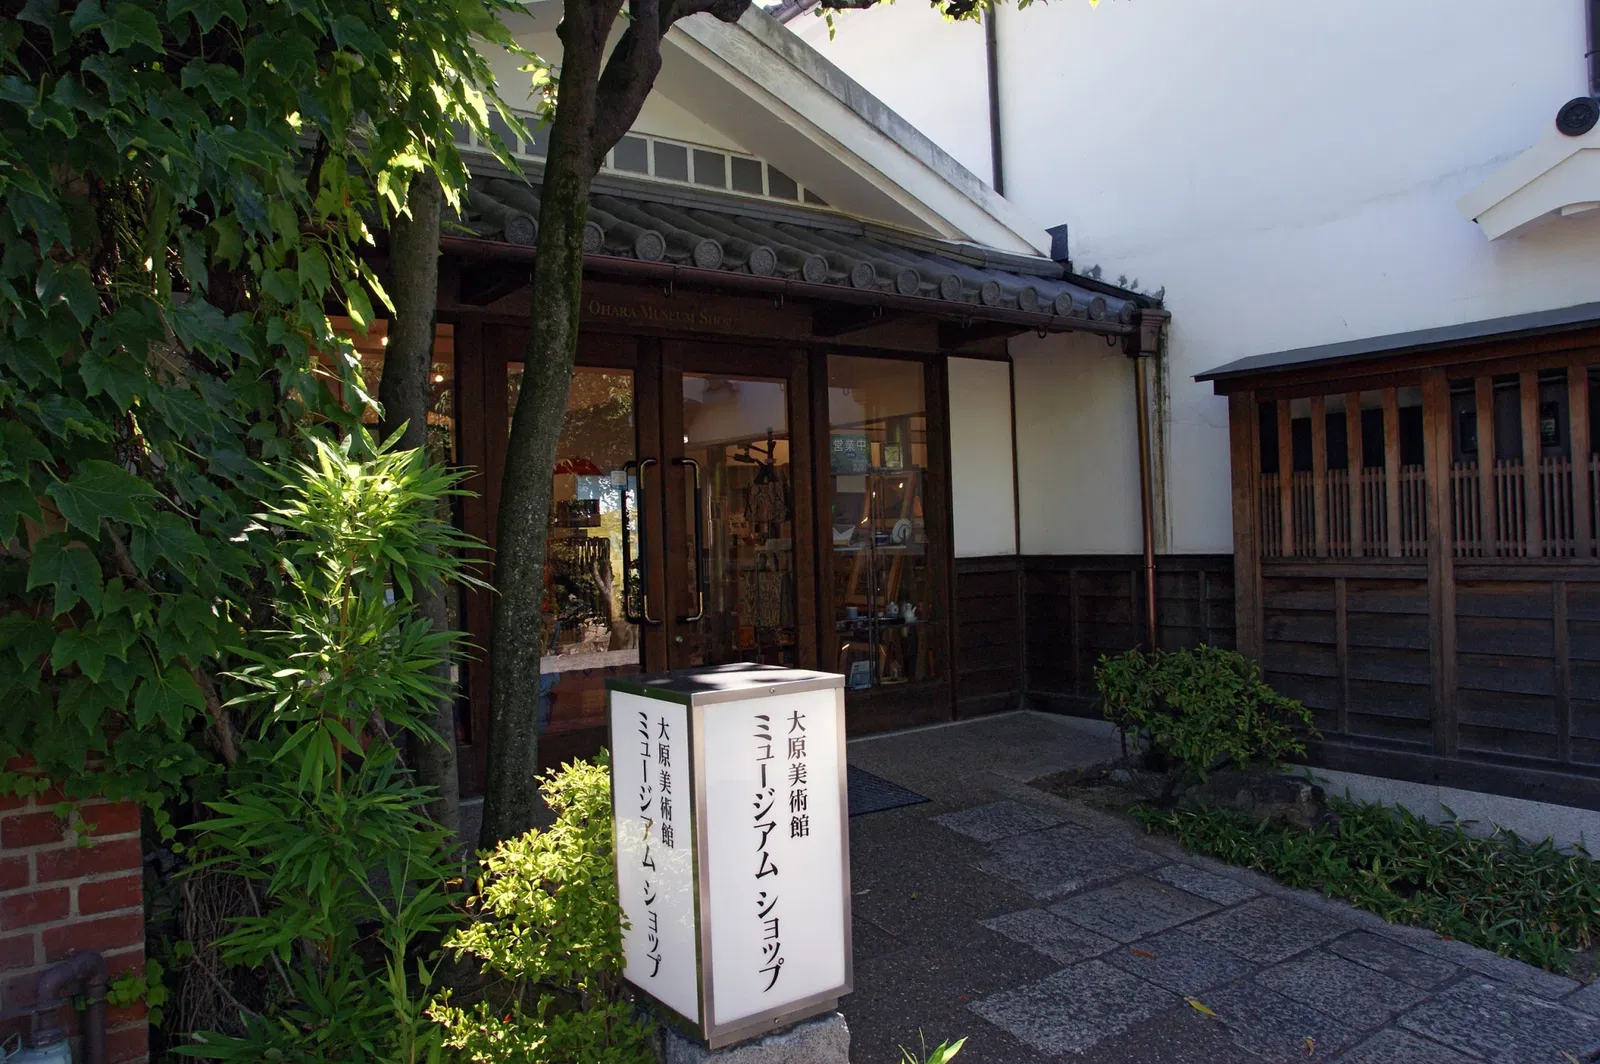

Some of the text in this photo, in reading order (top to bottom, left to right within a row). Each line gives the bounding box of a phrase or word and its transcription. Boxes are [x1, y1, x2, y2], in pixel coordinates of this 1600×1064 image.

[832, 438, 867, 452] 営業中
[657, 715, 675, 849] 大原美術館
[786, 710, 810, 838] 大原美術館
[637, 711, 663, 978] ミュージアム ショップ
[752, 714, 785, 993] ミュージアム ショップ
